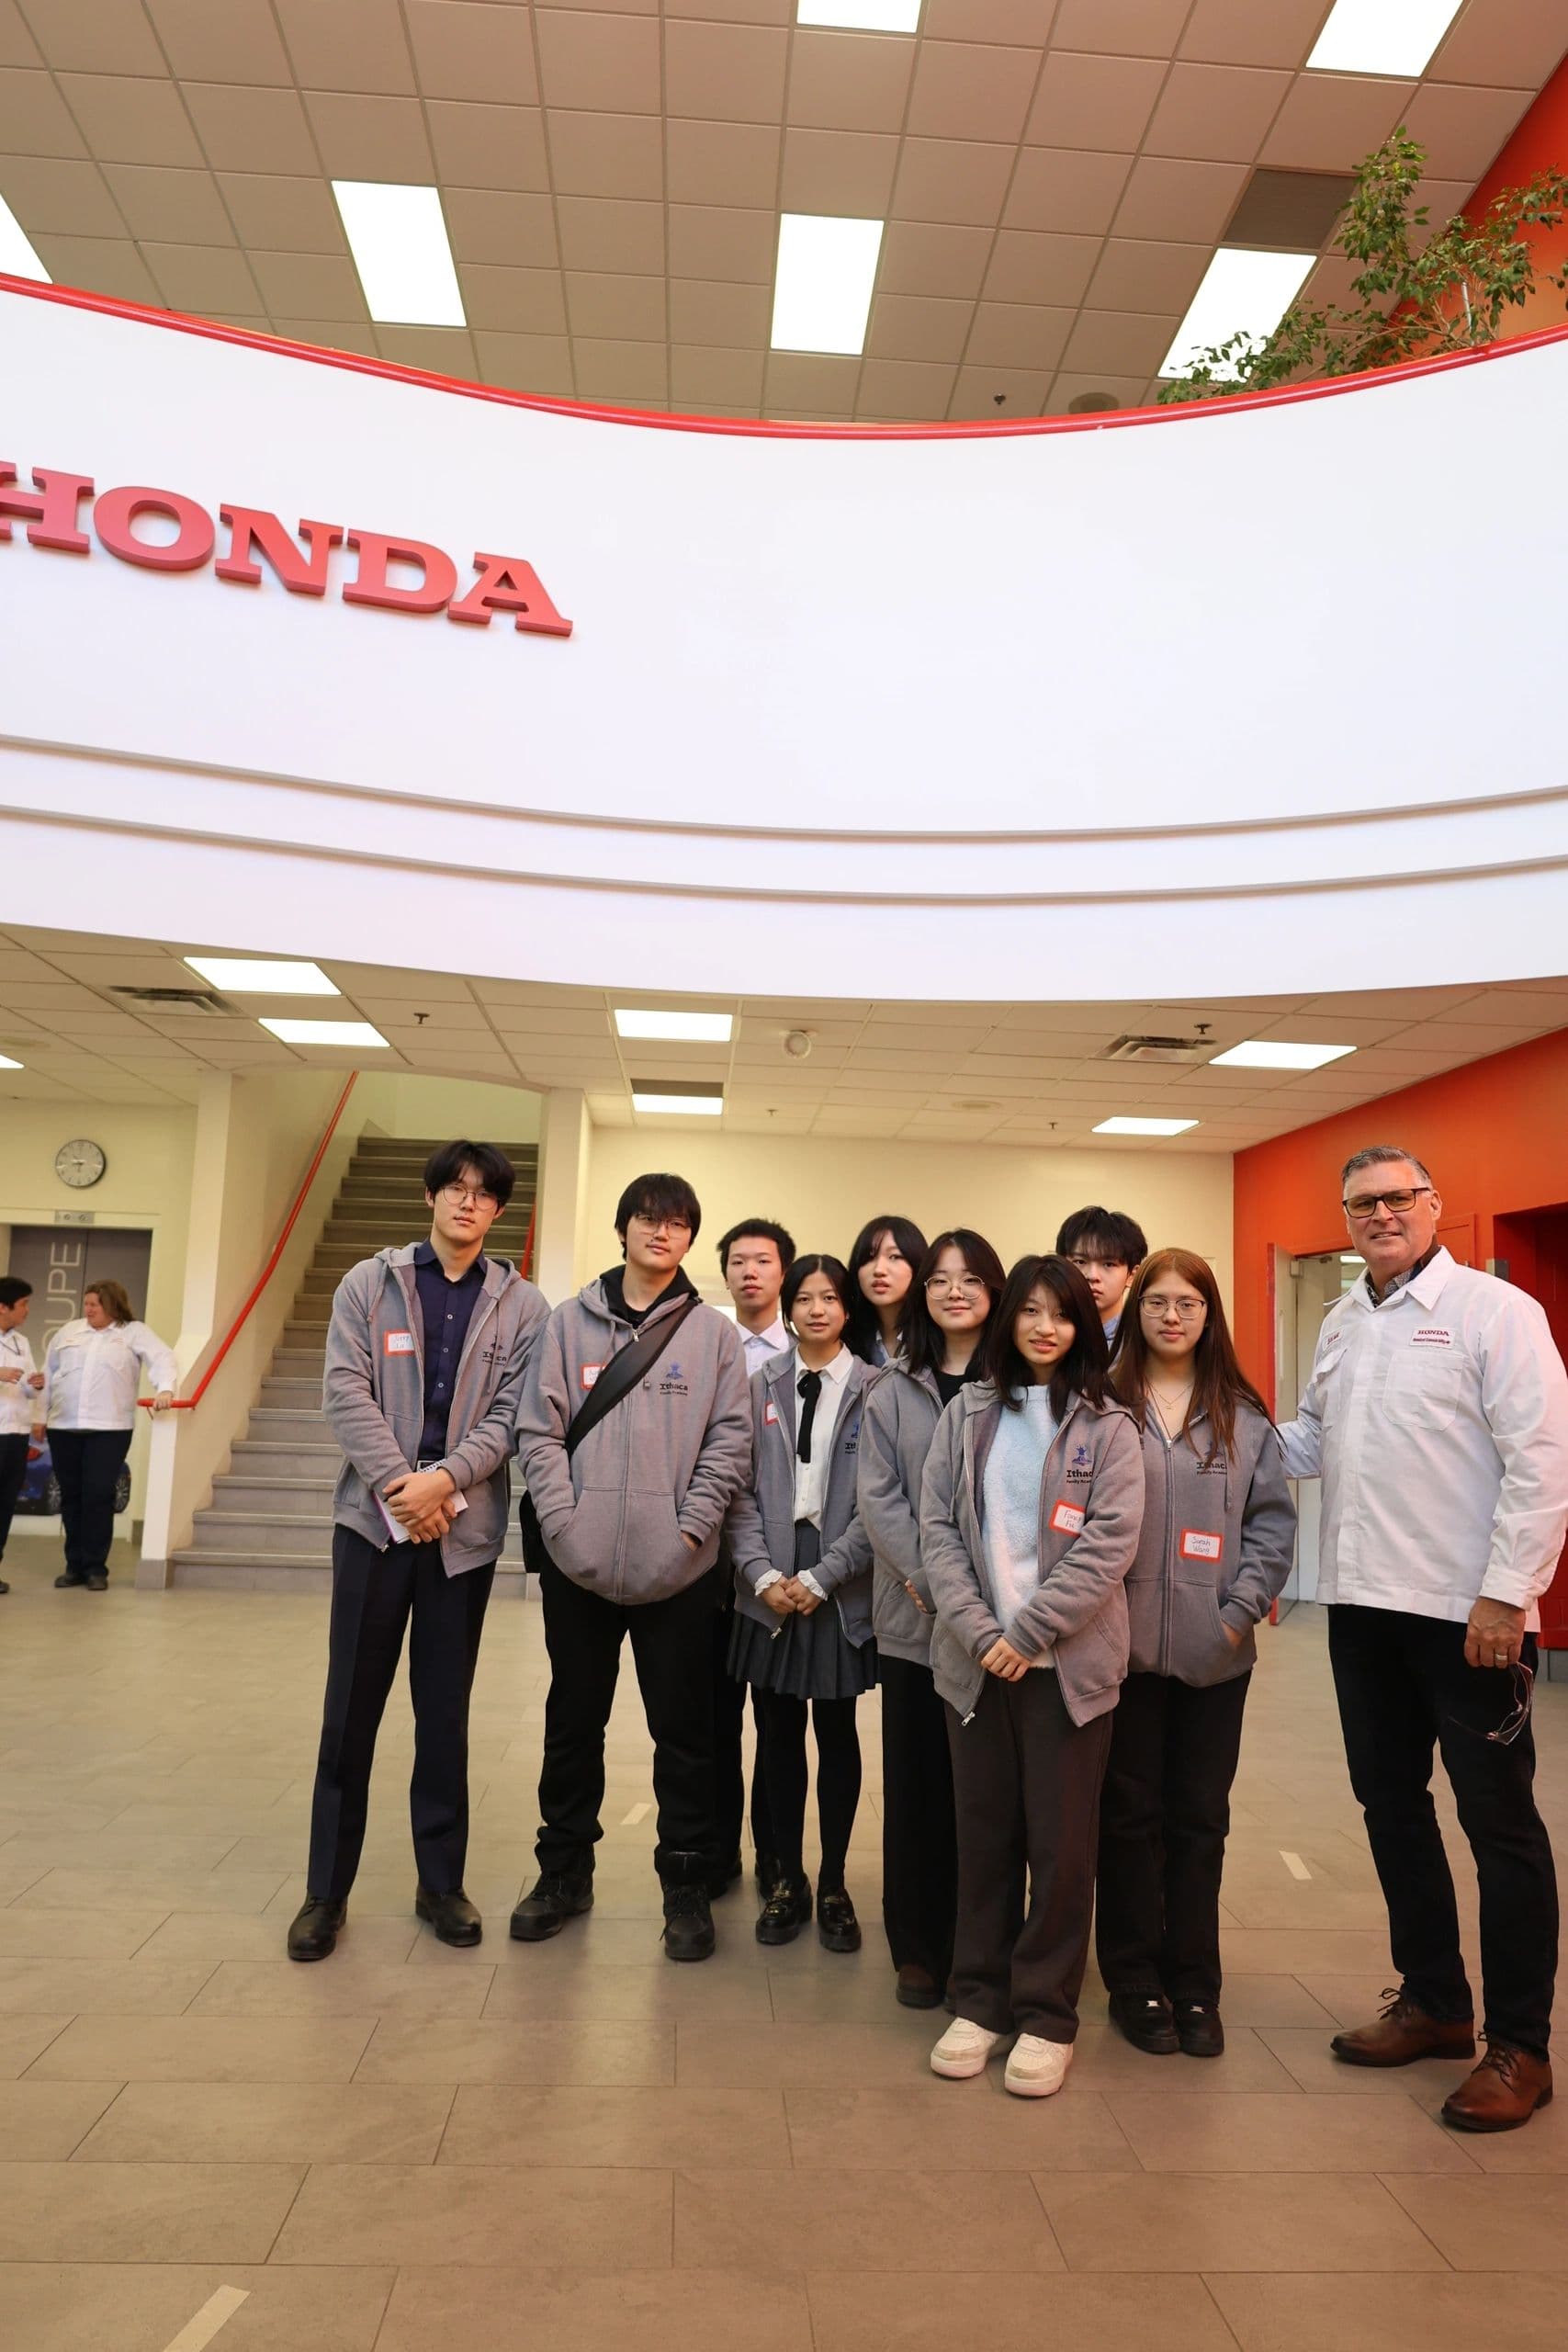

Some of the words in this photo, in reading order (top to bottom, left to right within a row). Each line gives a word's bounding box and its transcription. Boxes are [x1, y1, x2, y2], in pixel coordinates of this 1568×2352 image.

[0, 462, 573, 638] HONDA
[482, 1351, 507, 1362] Itca
[1066, 1469, 1093, 1478] Ithac
